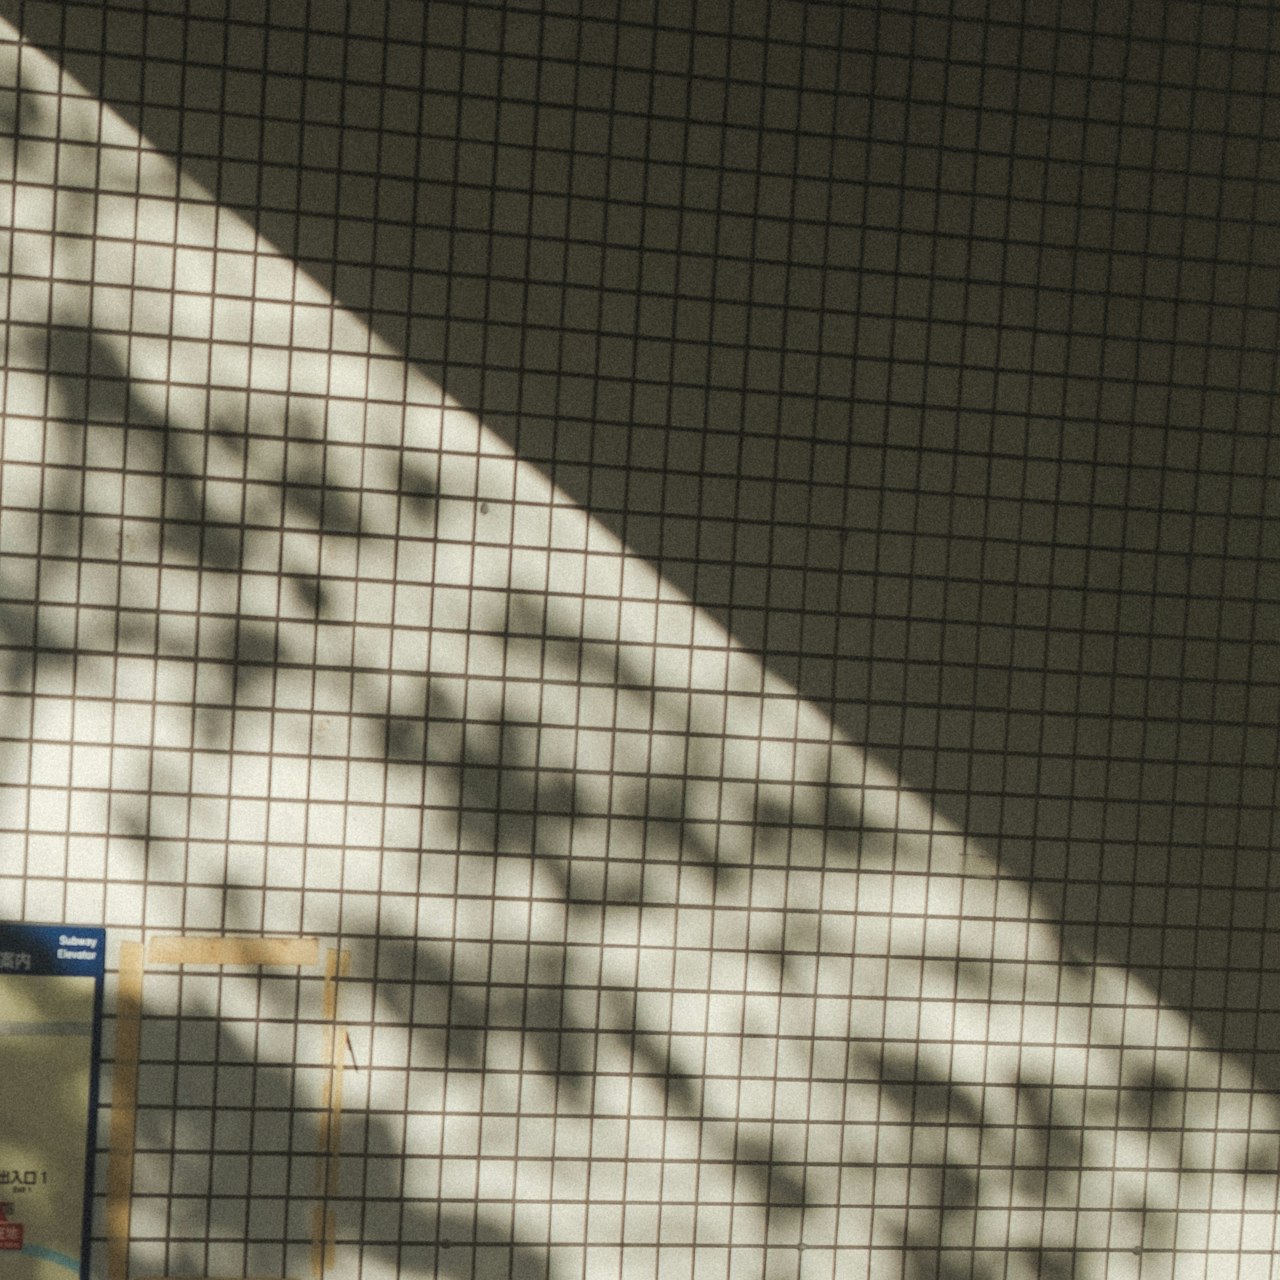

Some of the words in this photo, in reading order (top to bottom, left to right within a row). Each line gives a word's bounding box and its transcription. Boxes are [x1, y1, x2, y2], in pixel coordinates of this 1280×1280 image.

[58, 934, 98, 948] Subway
[56, 948, 97, 961] Elevator
[41, 1171, 48, 1185] 1
